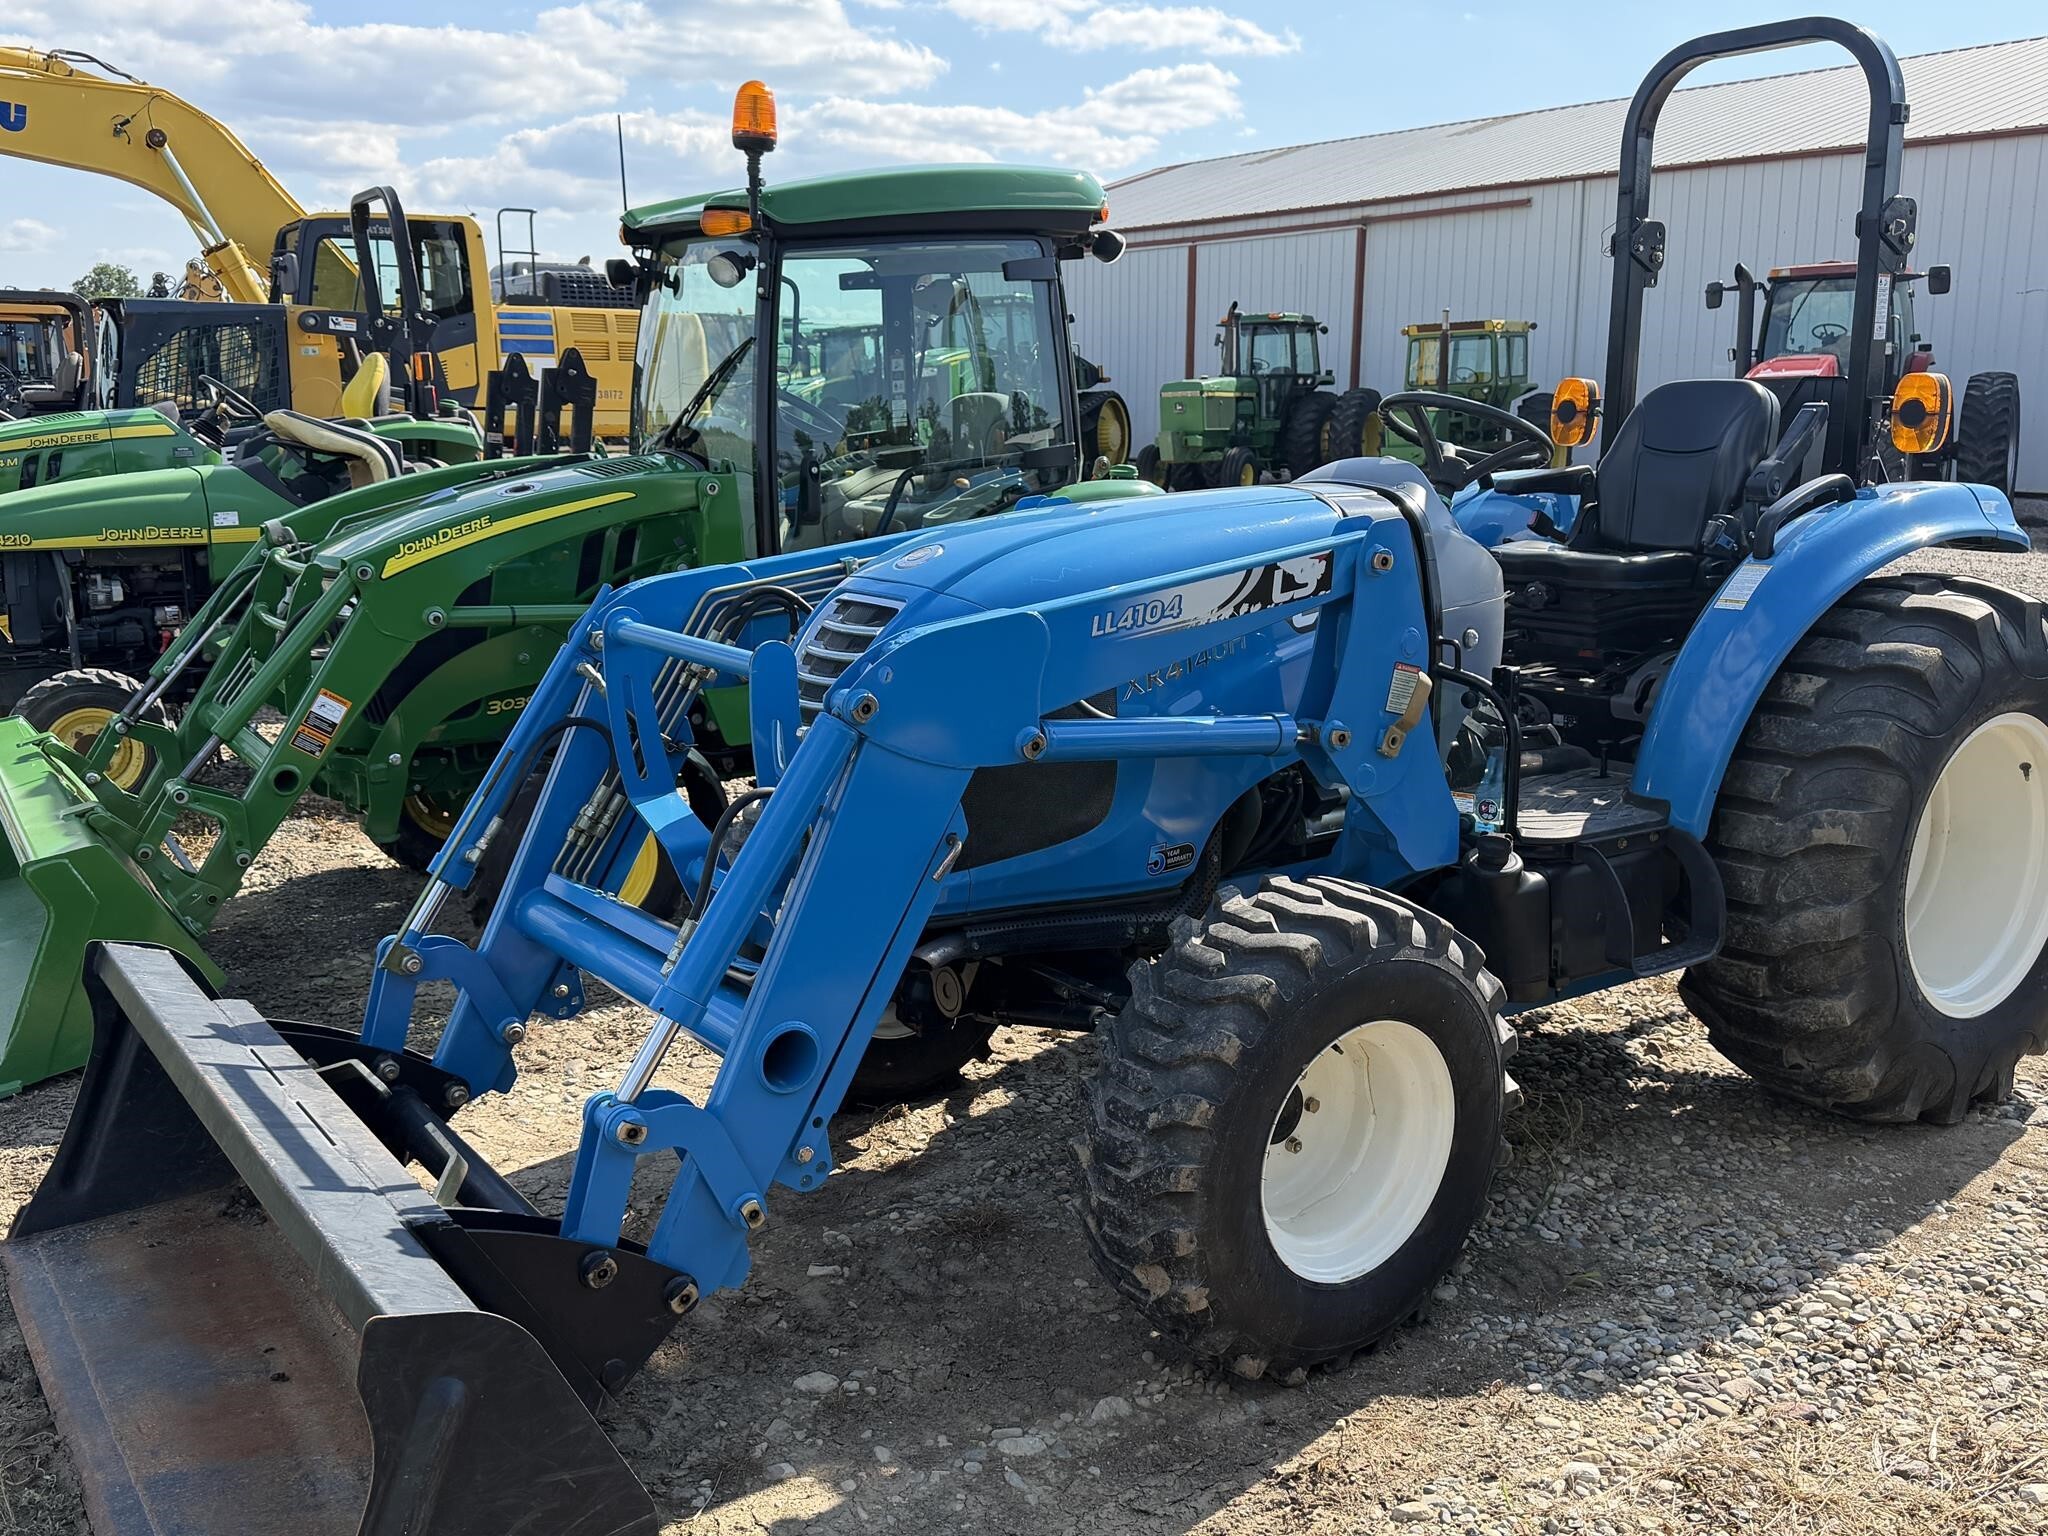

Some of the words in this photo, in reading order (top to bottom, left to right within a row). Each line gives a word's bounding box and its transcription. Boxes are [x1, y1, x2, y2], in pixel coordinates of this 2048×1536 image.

[343, 225, 392, 234] KATSU
[27, 437, 59, 447] JOHN
[61, 433, 99, 443] DEERE
[96, 527, 143, 540] JOHN
[145, 526, 202, 539] DEERE
[394, 534, 437, 558] JOHN
[438, 515, 492, 543] DEERE
[1091, 594, 1182, 638] LL4104
[1147, 843, 1166, 875] 5
[1167, 852, 1192, 865] WARRANTY
